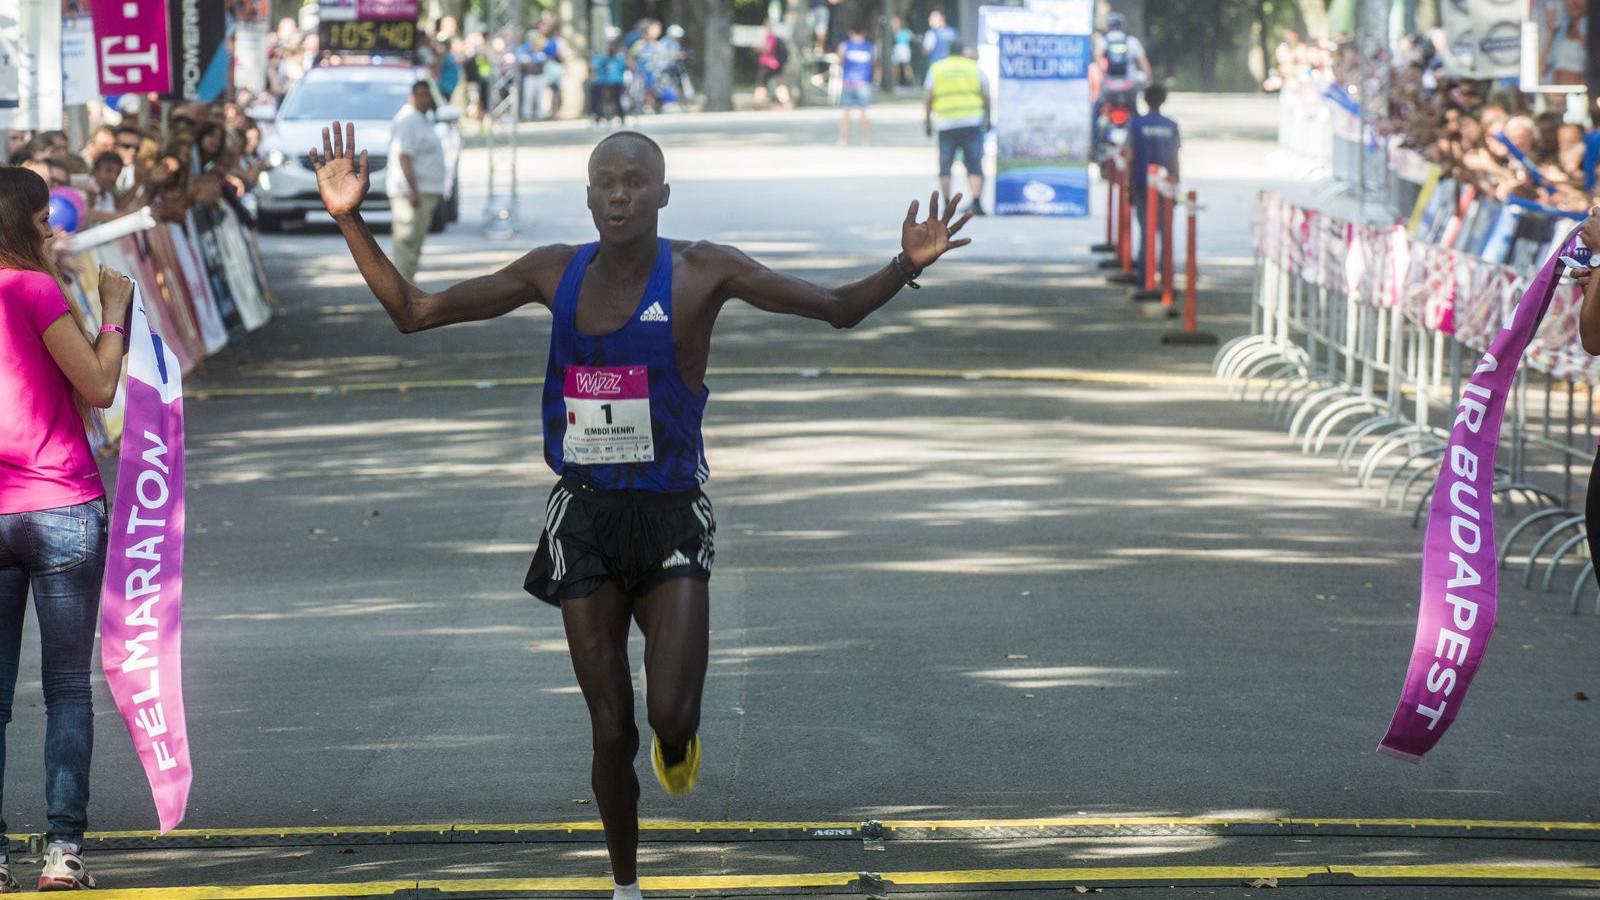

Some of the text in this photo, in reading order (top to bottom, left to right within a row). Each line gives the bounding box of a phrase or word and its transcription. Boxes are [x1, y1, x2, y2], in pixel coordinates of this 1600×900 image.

[640, 312, 668, 322] adidas
[601, 404, 613, 425] 1
[611, 426, 636, 435] HENRY
[1416, 353, 1498, 731] AIR BUDAPEST
[122, 430, 178, 771] FÉLMARATON
